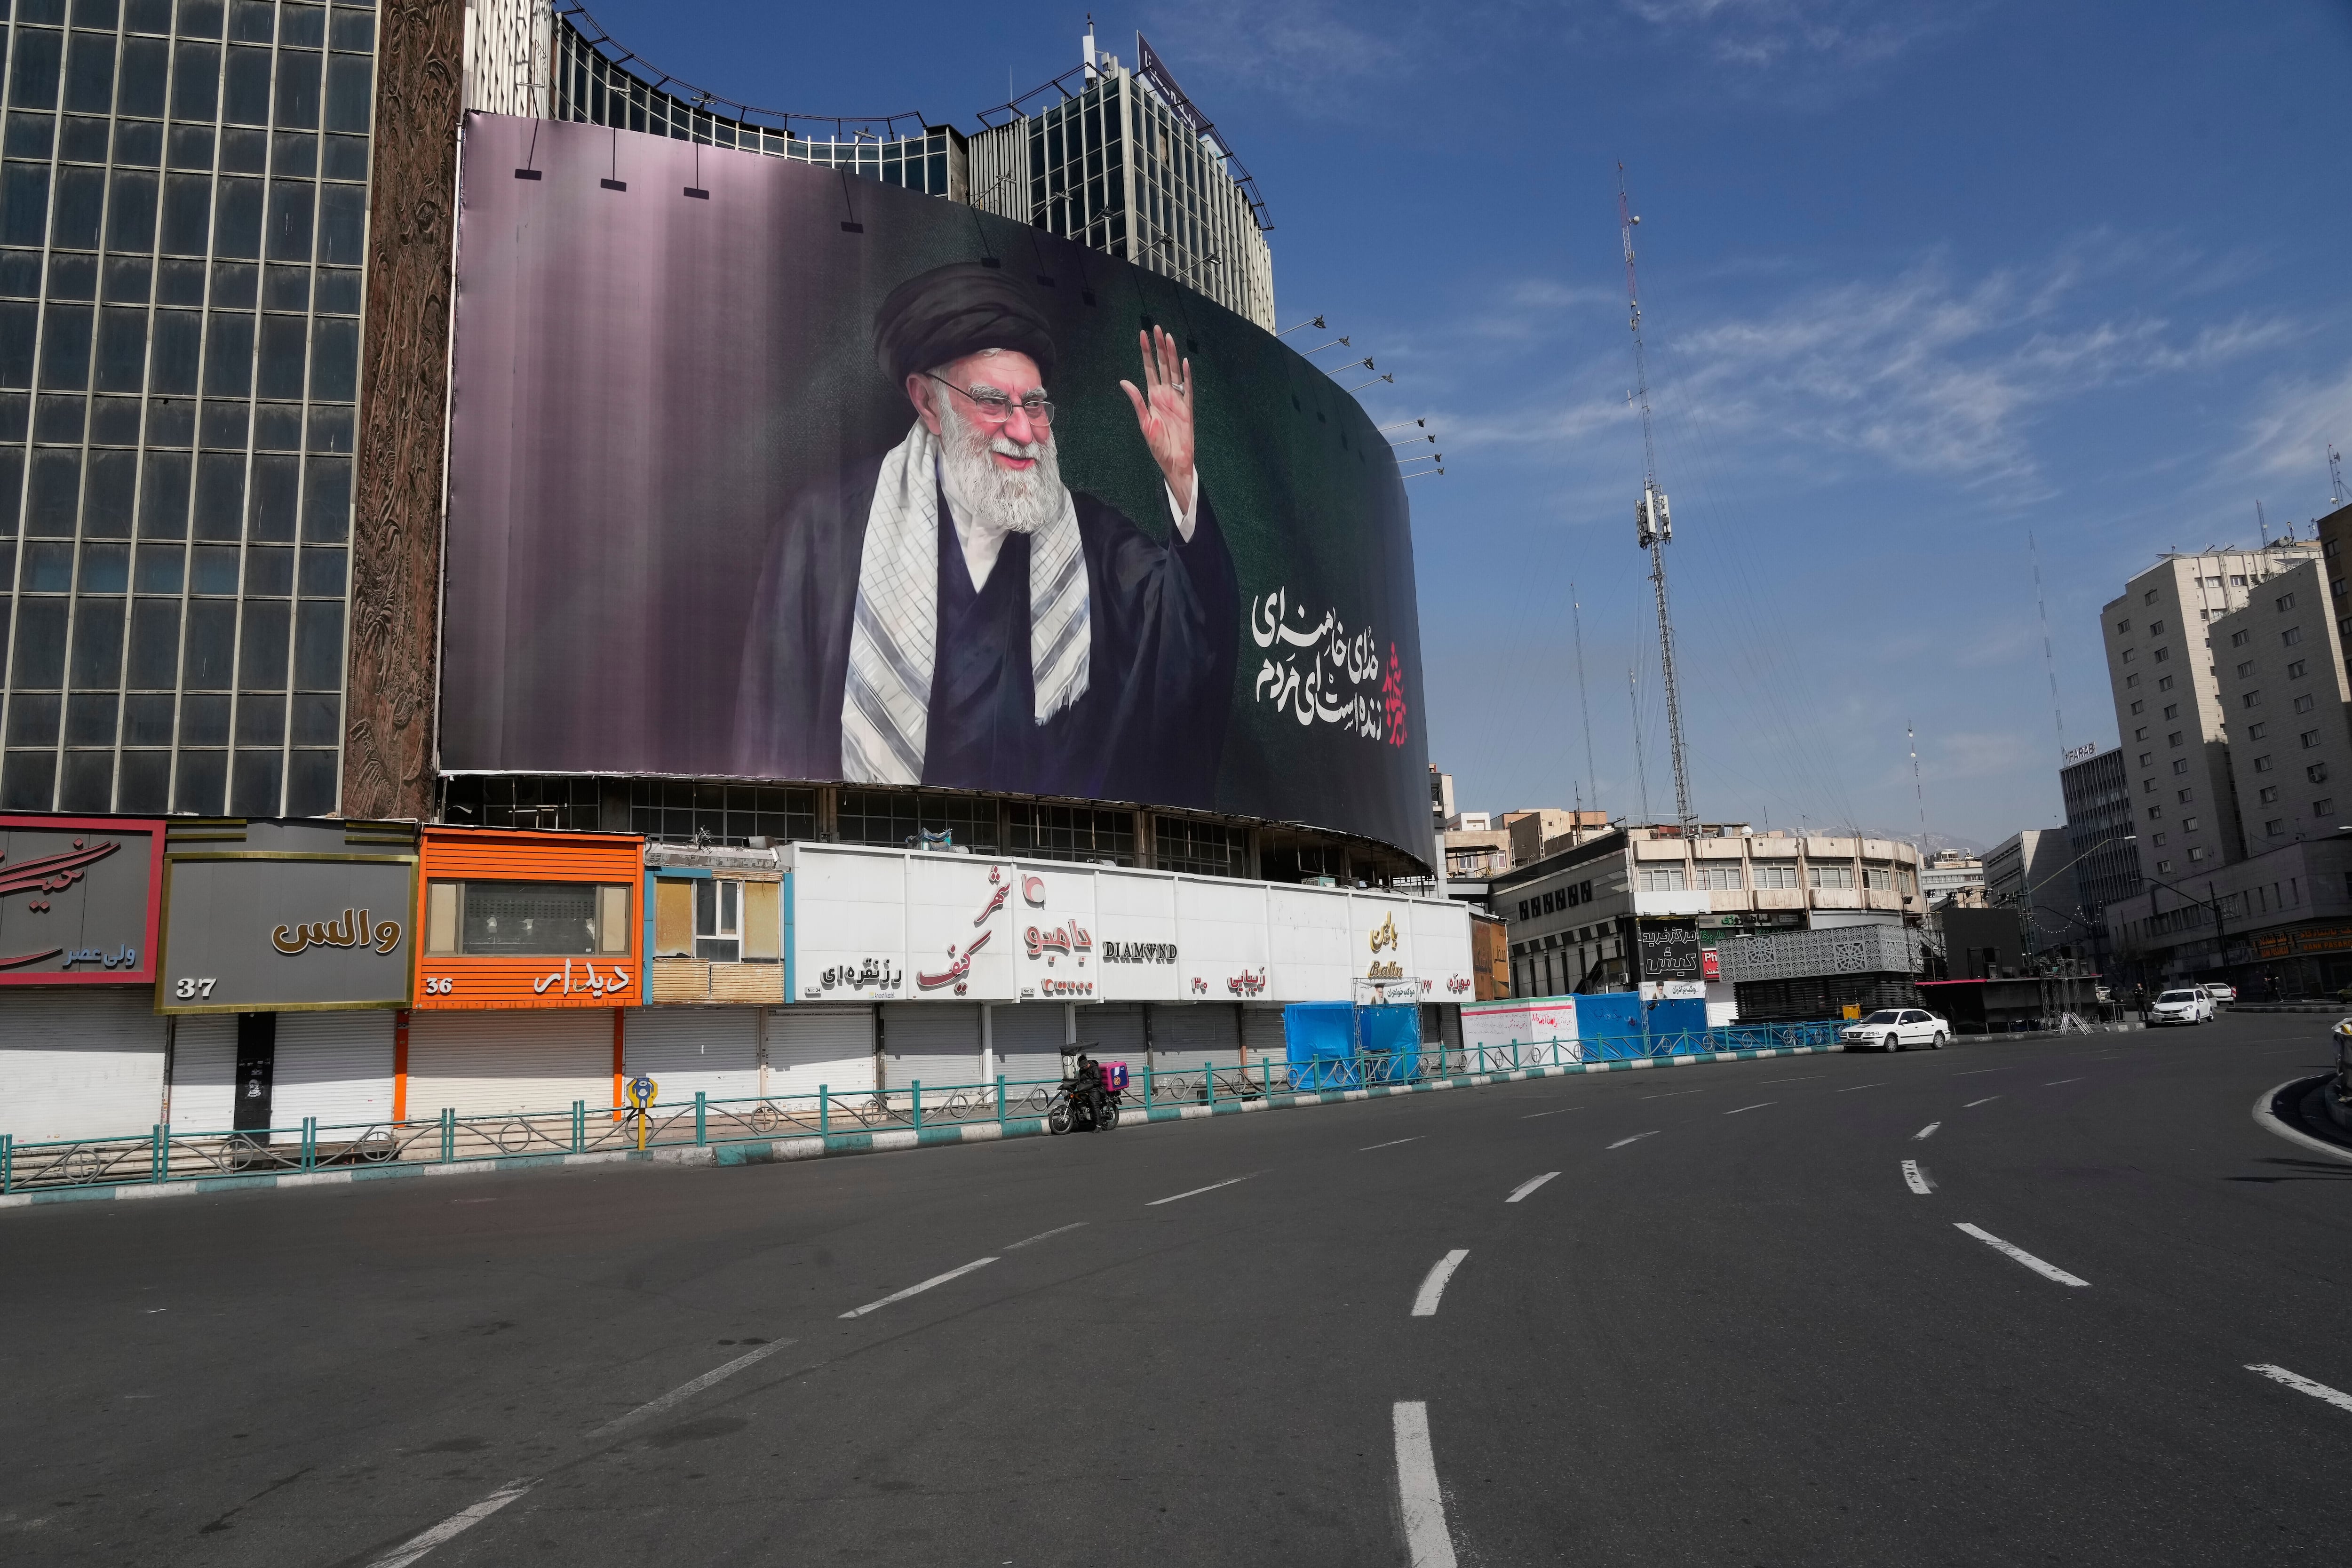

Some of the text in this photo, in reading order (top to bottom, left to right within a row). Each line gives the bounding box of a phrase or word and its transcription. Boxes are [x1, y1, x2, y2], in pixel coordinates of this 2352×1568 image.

[2069, 743, 2095, 763] FARAB
[974, 865, 1011, 923] شهر
[271, 908, 401, 954] والس
[1024, 919, 1094, 963] بامبو
[1642, 927, 1697, 947] مرکز خرید
[62, 943, 136, 967] ولی عصر
[919, 929, 993, 993] کیف
[1645, 947, 1697, 977] کیش
[533, 958, 630, 998] دیدار
[1230, 966, 1266, 992] زیبایی
[1369, 960, 1403, 978] Balin
[176, 978, 217, 999] 37
[425, 977, 453, 994] 36
[1449, 972, 1470, 990] موزه
[1672, 985, 1696, 995] وکب برادران
[1387, 987, 1415, 998] موکب خواهران
